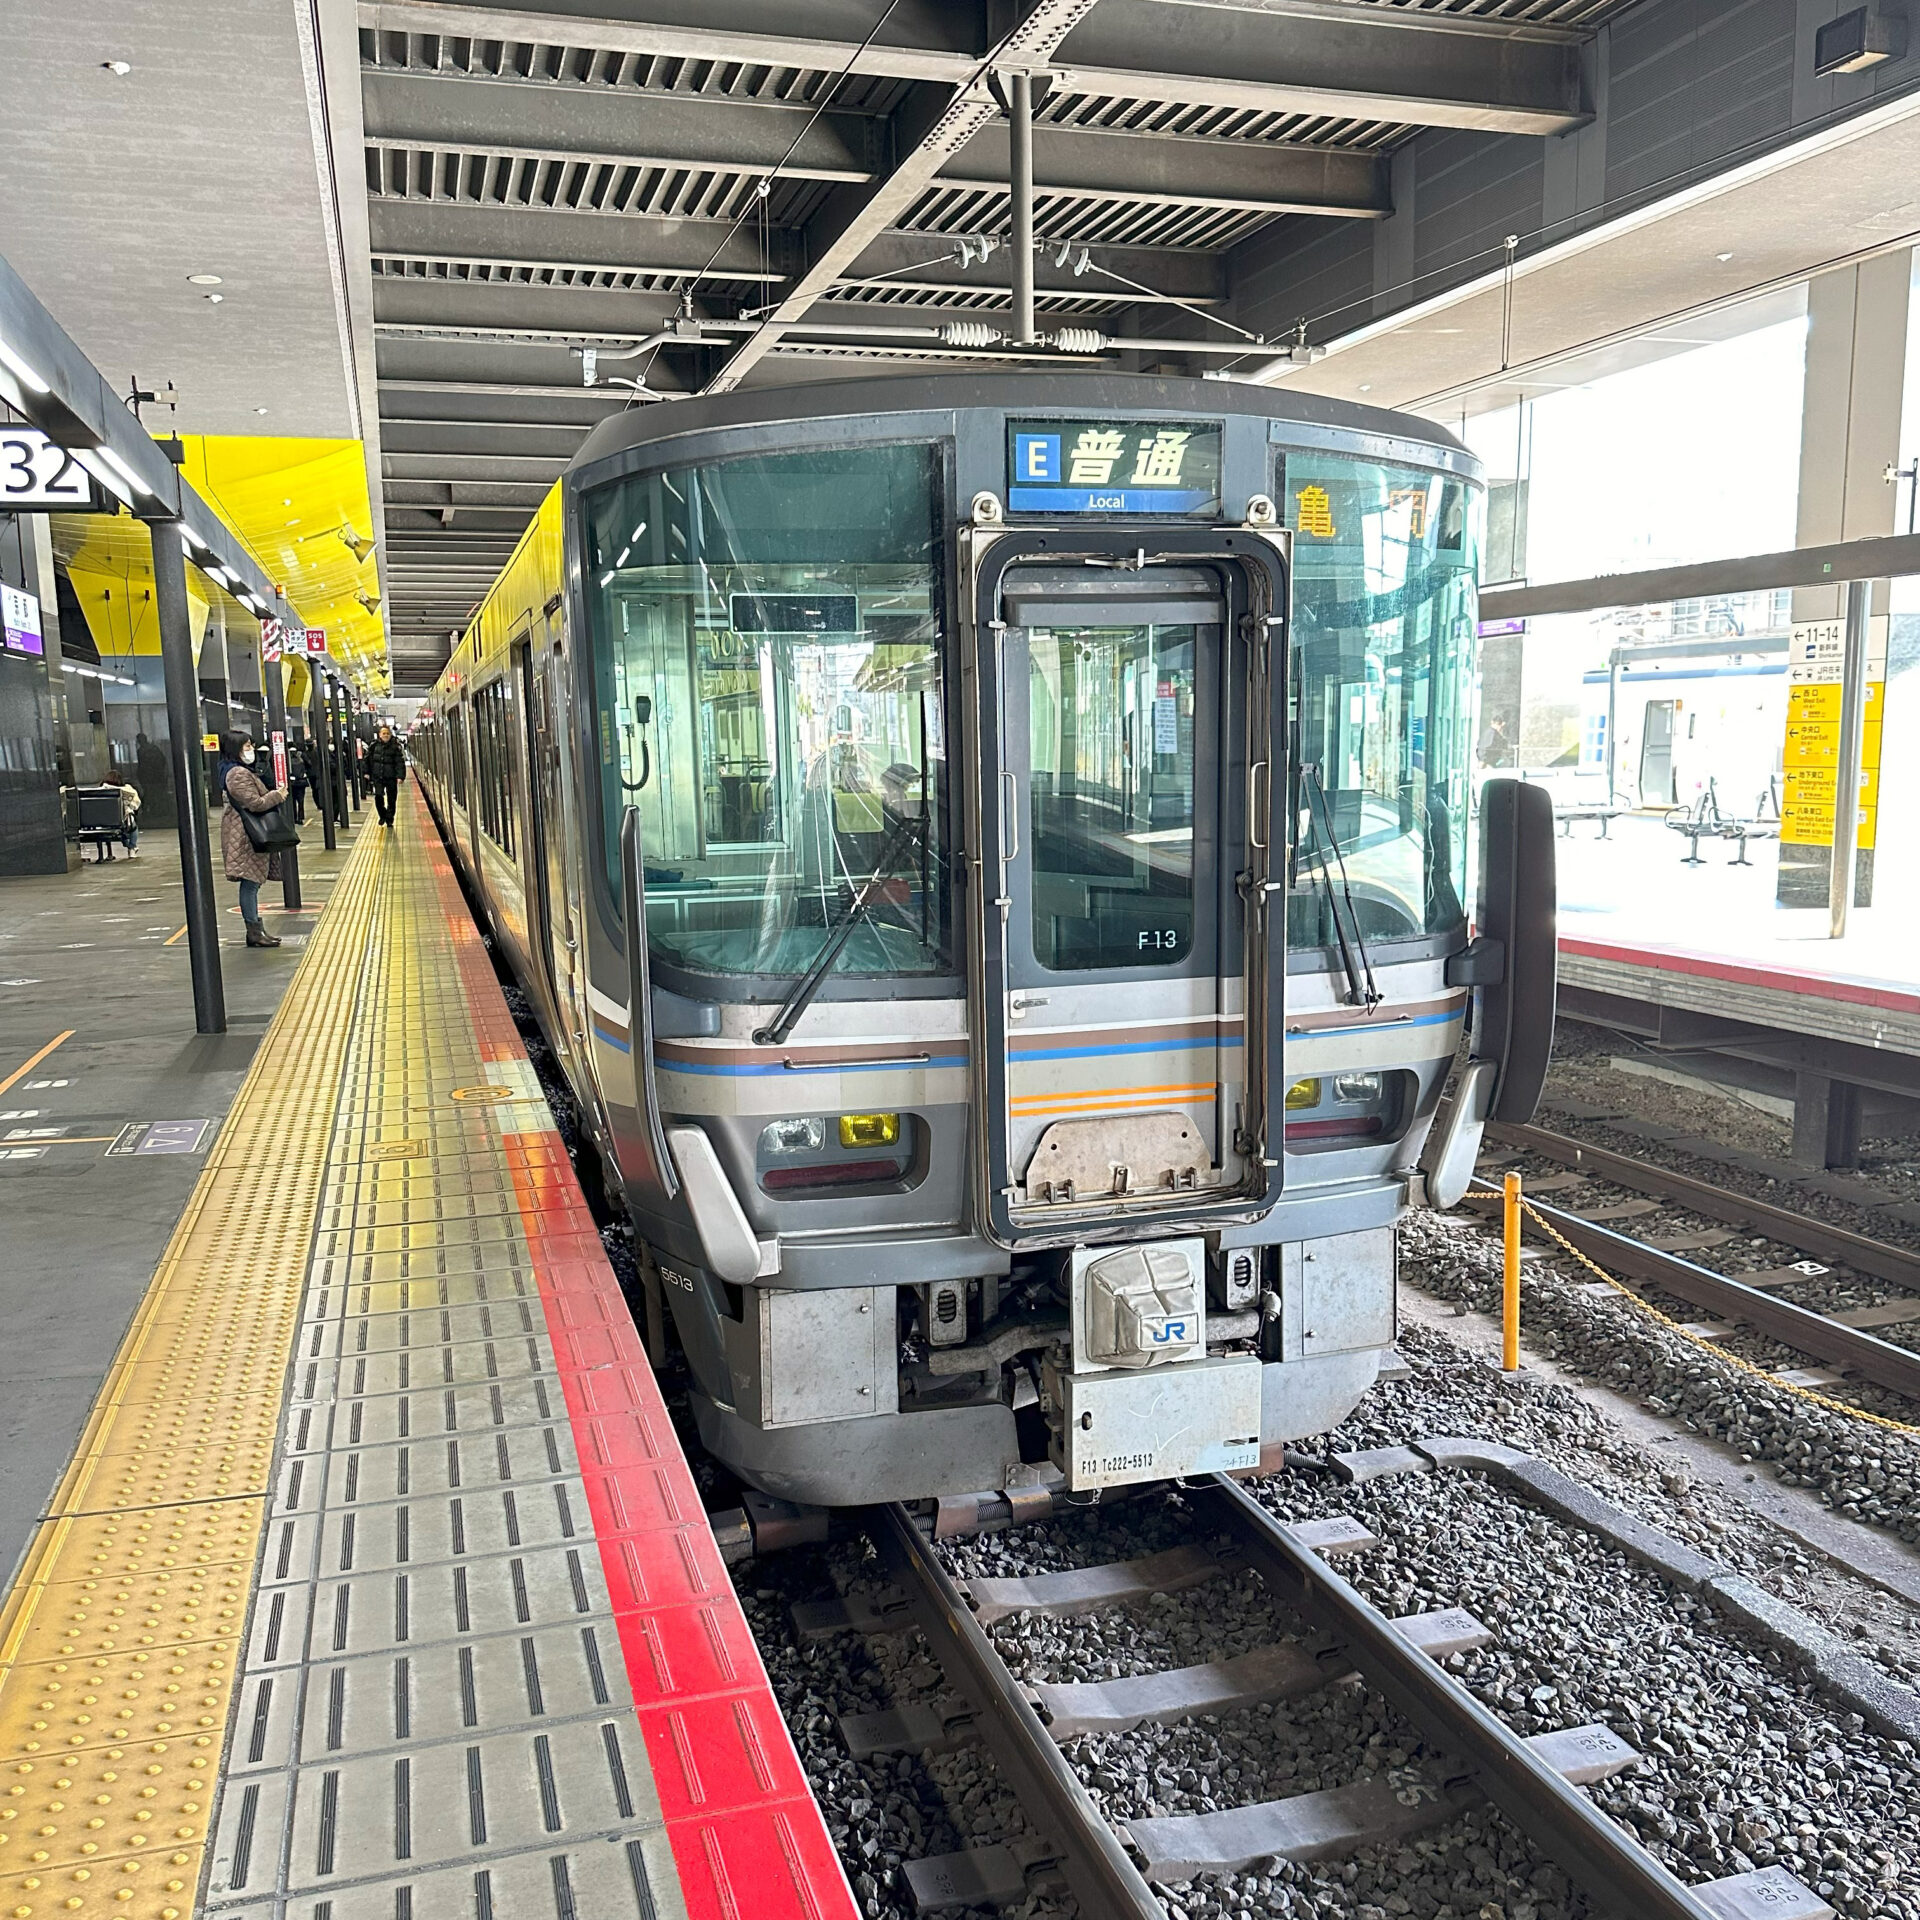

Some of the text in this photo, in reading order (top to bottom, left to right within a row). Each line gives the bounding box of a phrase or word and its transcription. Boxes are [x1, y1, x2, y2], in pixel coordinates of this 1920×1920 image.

[2, 440, 79, 494] 32
[1028, 429, 1192, 485] E 普通
[1089, 494, 1125, 508] Local
[1806, 626, 1838, 642] 11-14
[1138, 930, 1176, 950] F13
[660, 1266, 694, 1292] 5513
[1153, 1322, 1186, 1343] JR
[1082, 1453, 1153, 1474] F13 Tc222-5513
